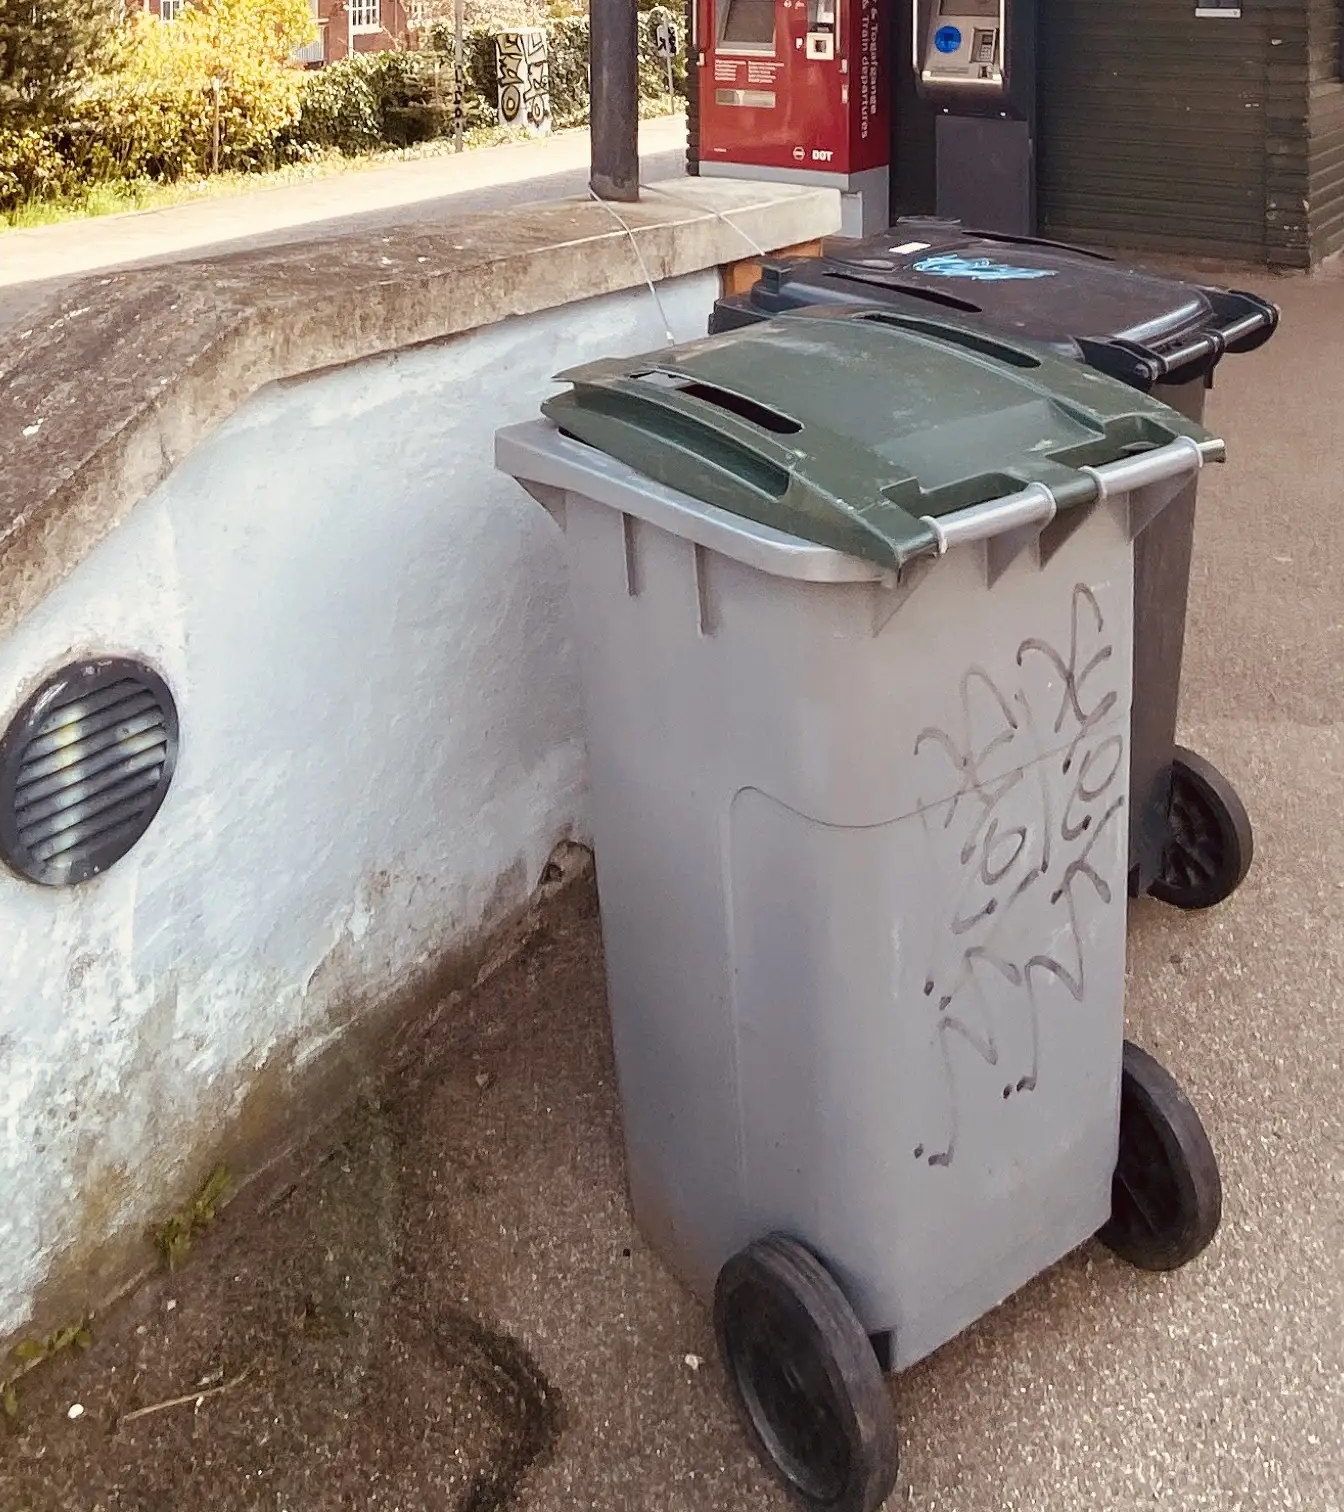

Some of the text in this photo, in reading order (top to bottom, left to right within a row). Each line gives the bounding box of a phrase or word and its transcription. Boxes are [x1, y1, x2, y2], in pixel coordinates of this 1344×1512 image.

[871, 7, 878, 20] &
[861, 56, 869, 139] departures
[812, 149, 834, 161] DOT
